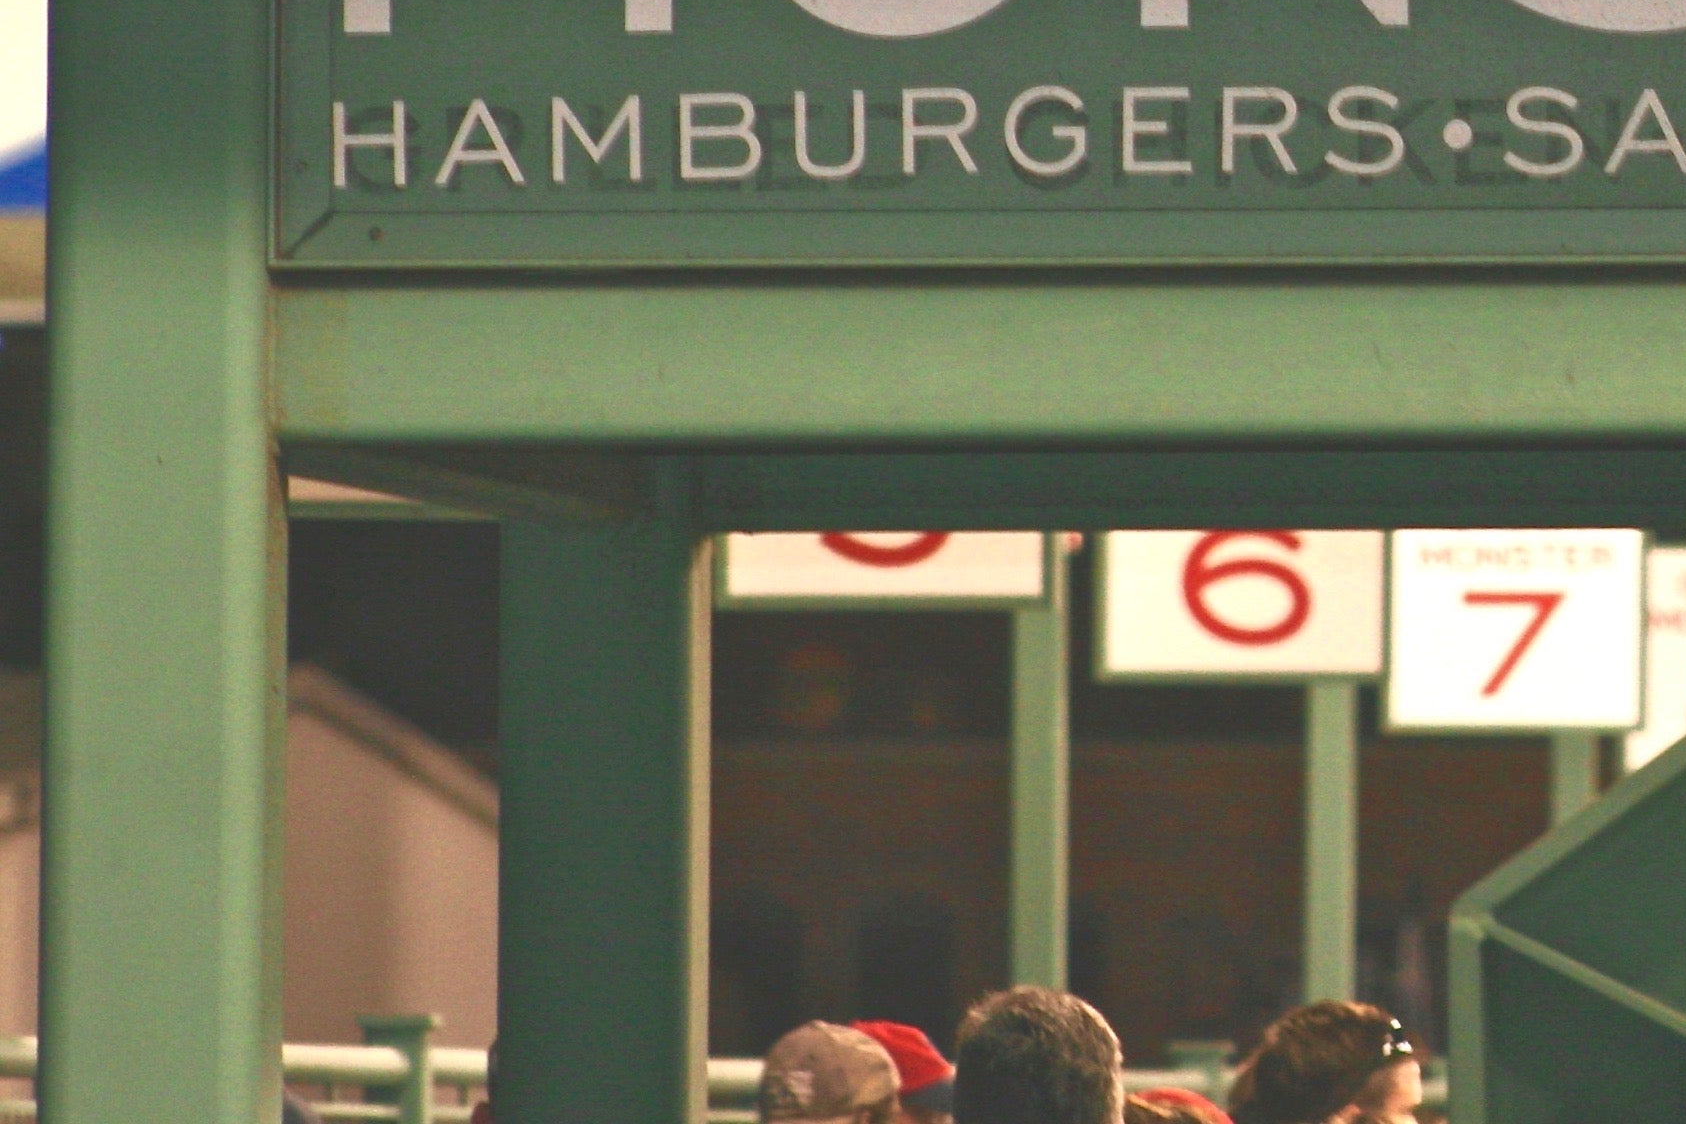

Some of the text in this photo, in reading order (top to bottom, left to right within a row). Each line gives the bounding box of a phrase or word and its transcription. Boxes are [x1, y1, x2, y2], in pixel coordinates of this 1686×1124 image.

[333, 85, 1407, 189] HAMBURGERS
[1180, 530, 1314, 645] 6
[1461, 590, 1565, 698] 7
